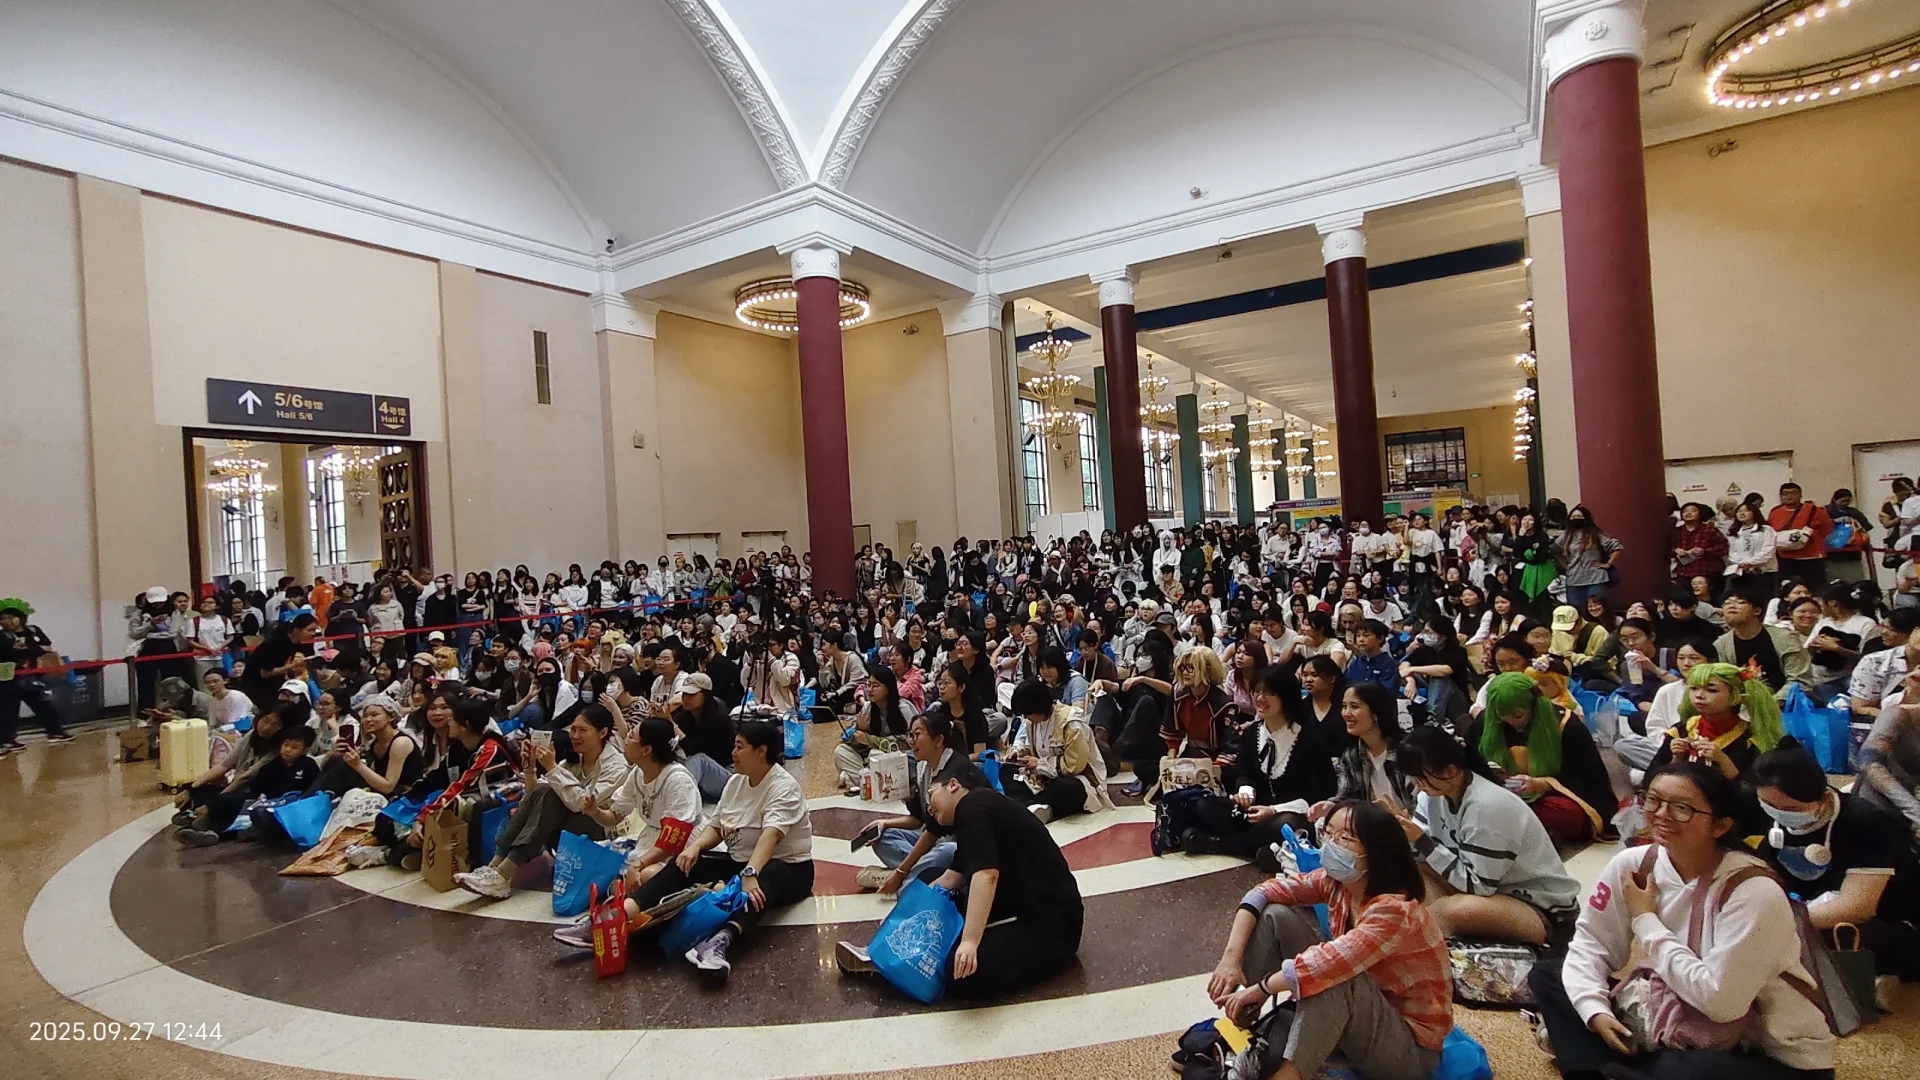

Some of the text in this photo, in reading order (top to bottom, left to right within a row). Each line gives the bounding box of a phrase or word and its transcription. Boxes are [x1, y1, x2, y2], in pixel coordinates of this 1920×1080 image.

[274, 392, 324, 411] 5/6号馆
[379, 401, 406, 416] 4号馆
[276, 410, 314, 421] Hall 5/6
[381, 415, 406, 424] Hall 4
[1589, 881, 1612, 911] 3
